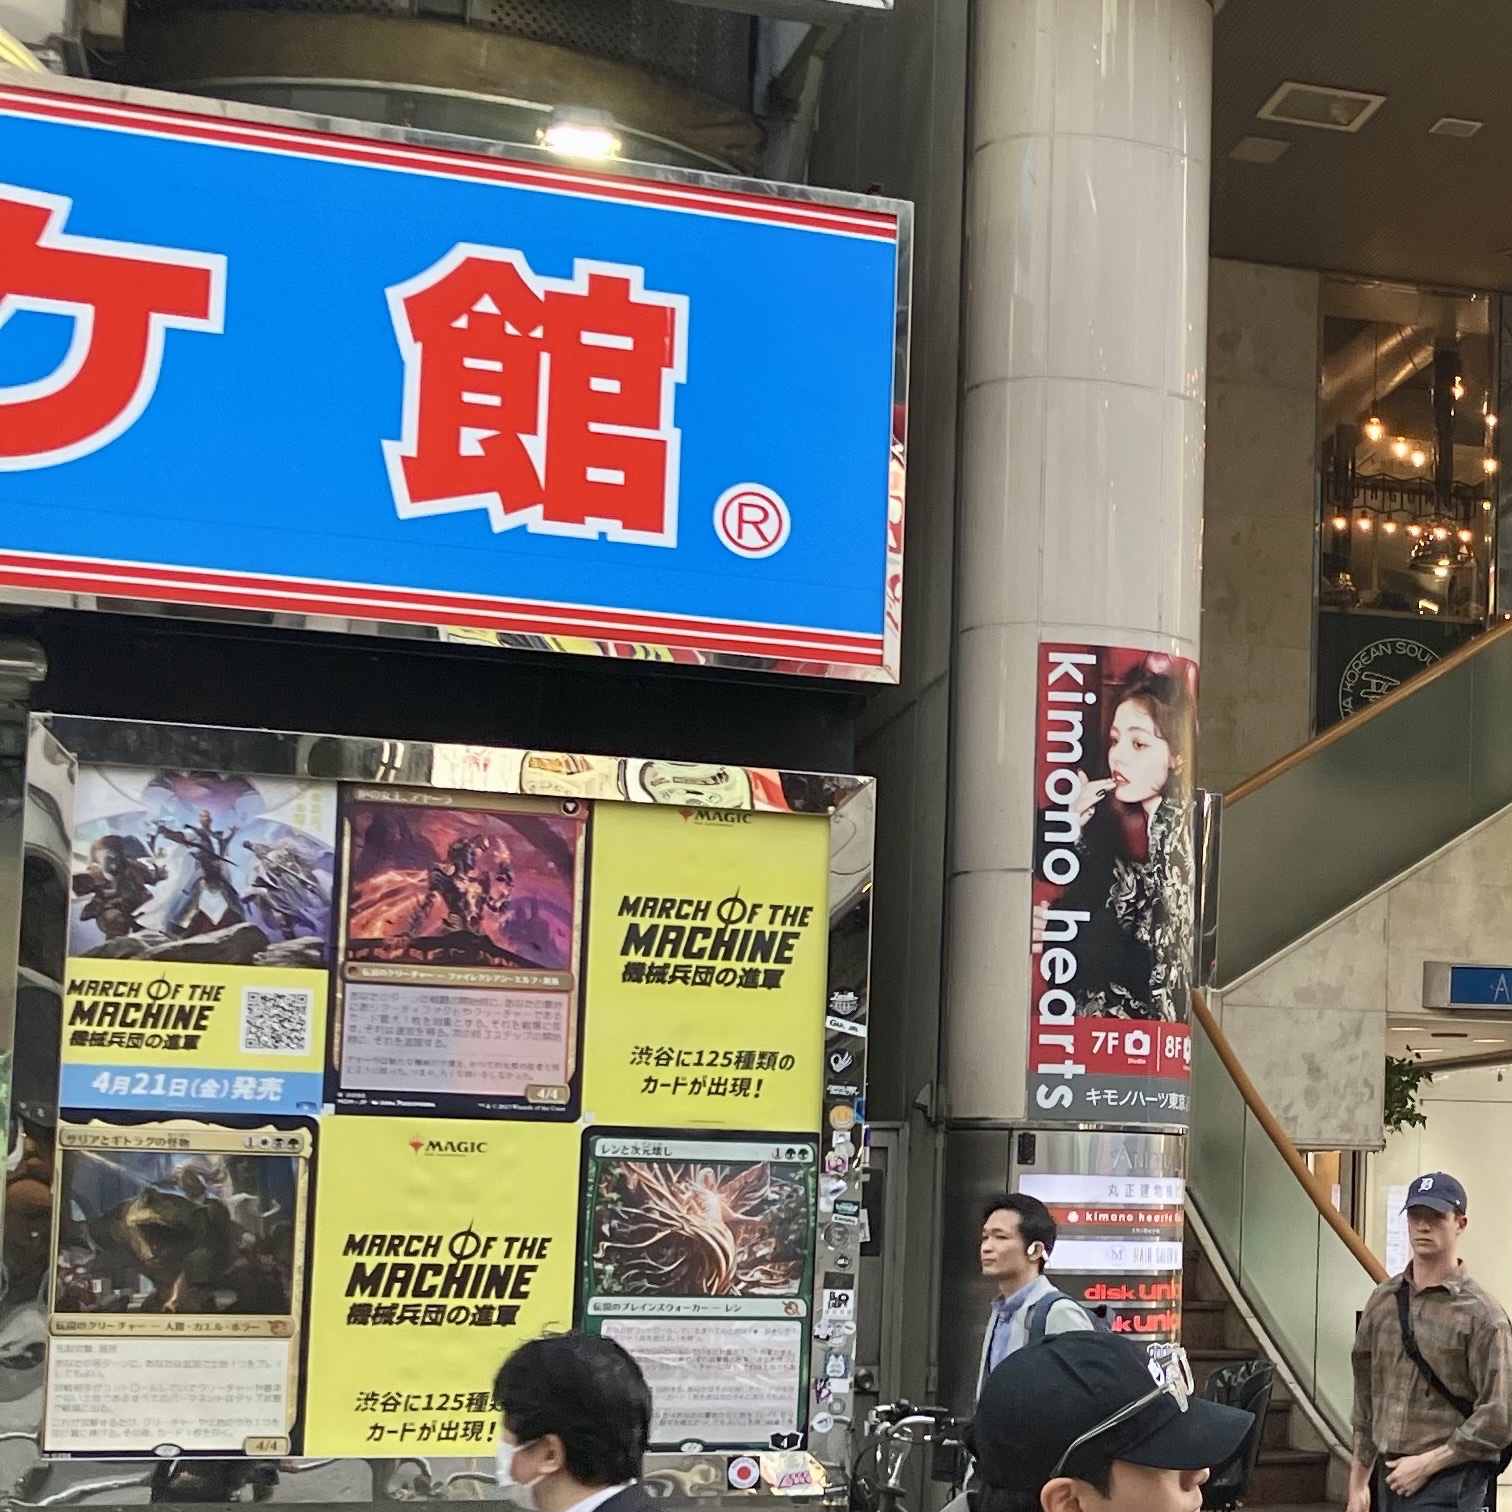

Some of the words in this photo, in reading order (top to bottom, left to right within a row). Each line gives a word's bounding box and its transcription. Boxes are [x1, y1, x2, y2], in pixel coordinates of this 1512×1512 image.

[1343, 643, 1393, 693] KOREAN
[1043, 652, 1098, 886] kimono
[694, 810, 753, 824] MAGIC
[618, 896, 711, 922] MARCH
[717, 892, 763, 926] OF
[768, 904, 814, 927] THE
[620, 923, 802, 965] MACHINE
[67, 978, 141, 998] MARCH
[147, 973, 184, 1002] OF
[189, 983, 226, 1002] THE
[621, 963, 785, 991] 機械兵団の進軍
[68, 1000, 215, 1031] MACHINE
[1036, 911, 1091, 1110] hearts
[69, 1030, 202, 1051] 機械兵団の進軍
[1091, 1031, 1119, 1055] 7F
[1164, 1035, 1182, 1058] 8F
[630, 1045, 795, 1072] 渋谷に125種類の
[92, 1070, 284, 1102] 4月21日(金)発売
[425, 1140, 488, 1153] MAGIC
[1085, 1211, 1134, 1223] kimono
[342, 1233, 443, 1257] MARCH
[448, 1229, 498, 1260] OF
[503, 1236, 553, 1259] THE
[345, 1262, 538, 1300] MACHINE
[1084, 1283, 1136, 1300] disk
[346, 1302, 521, 1327] 機械兵団の進軍
[256, 1439, 278, 1451] 4/4
